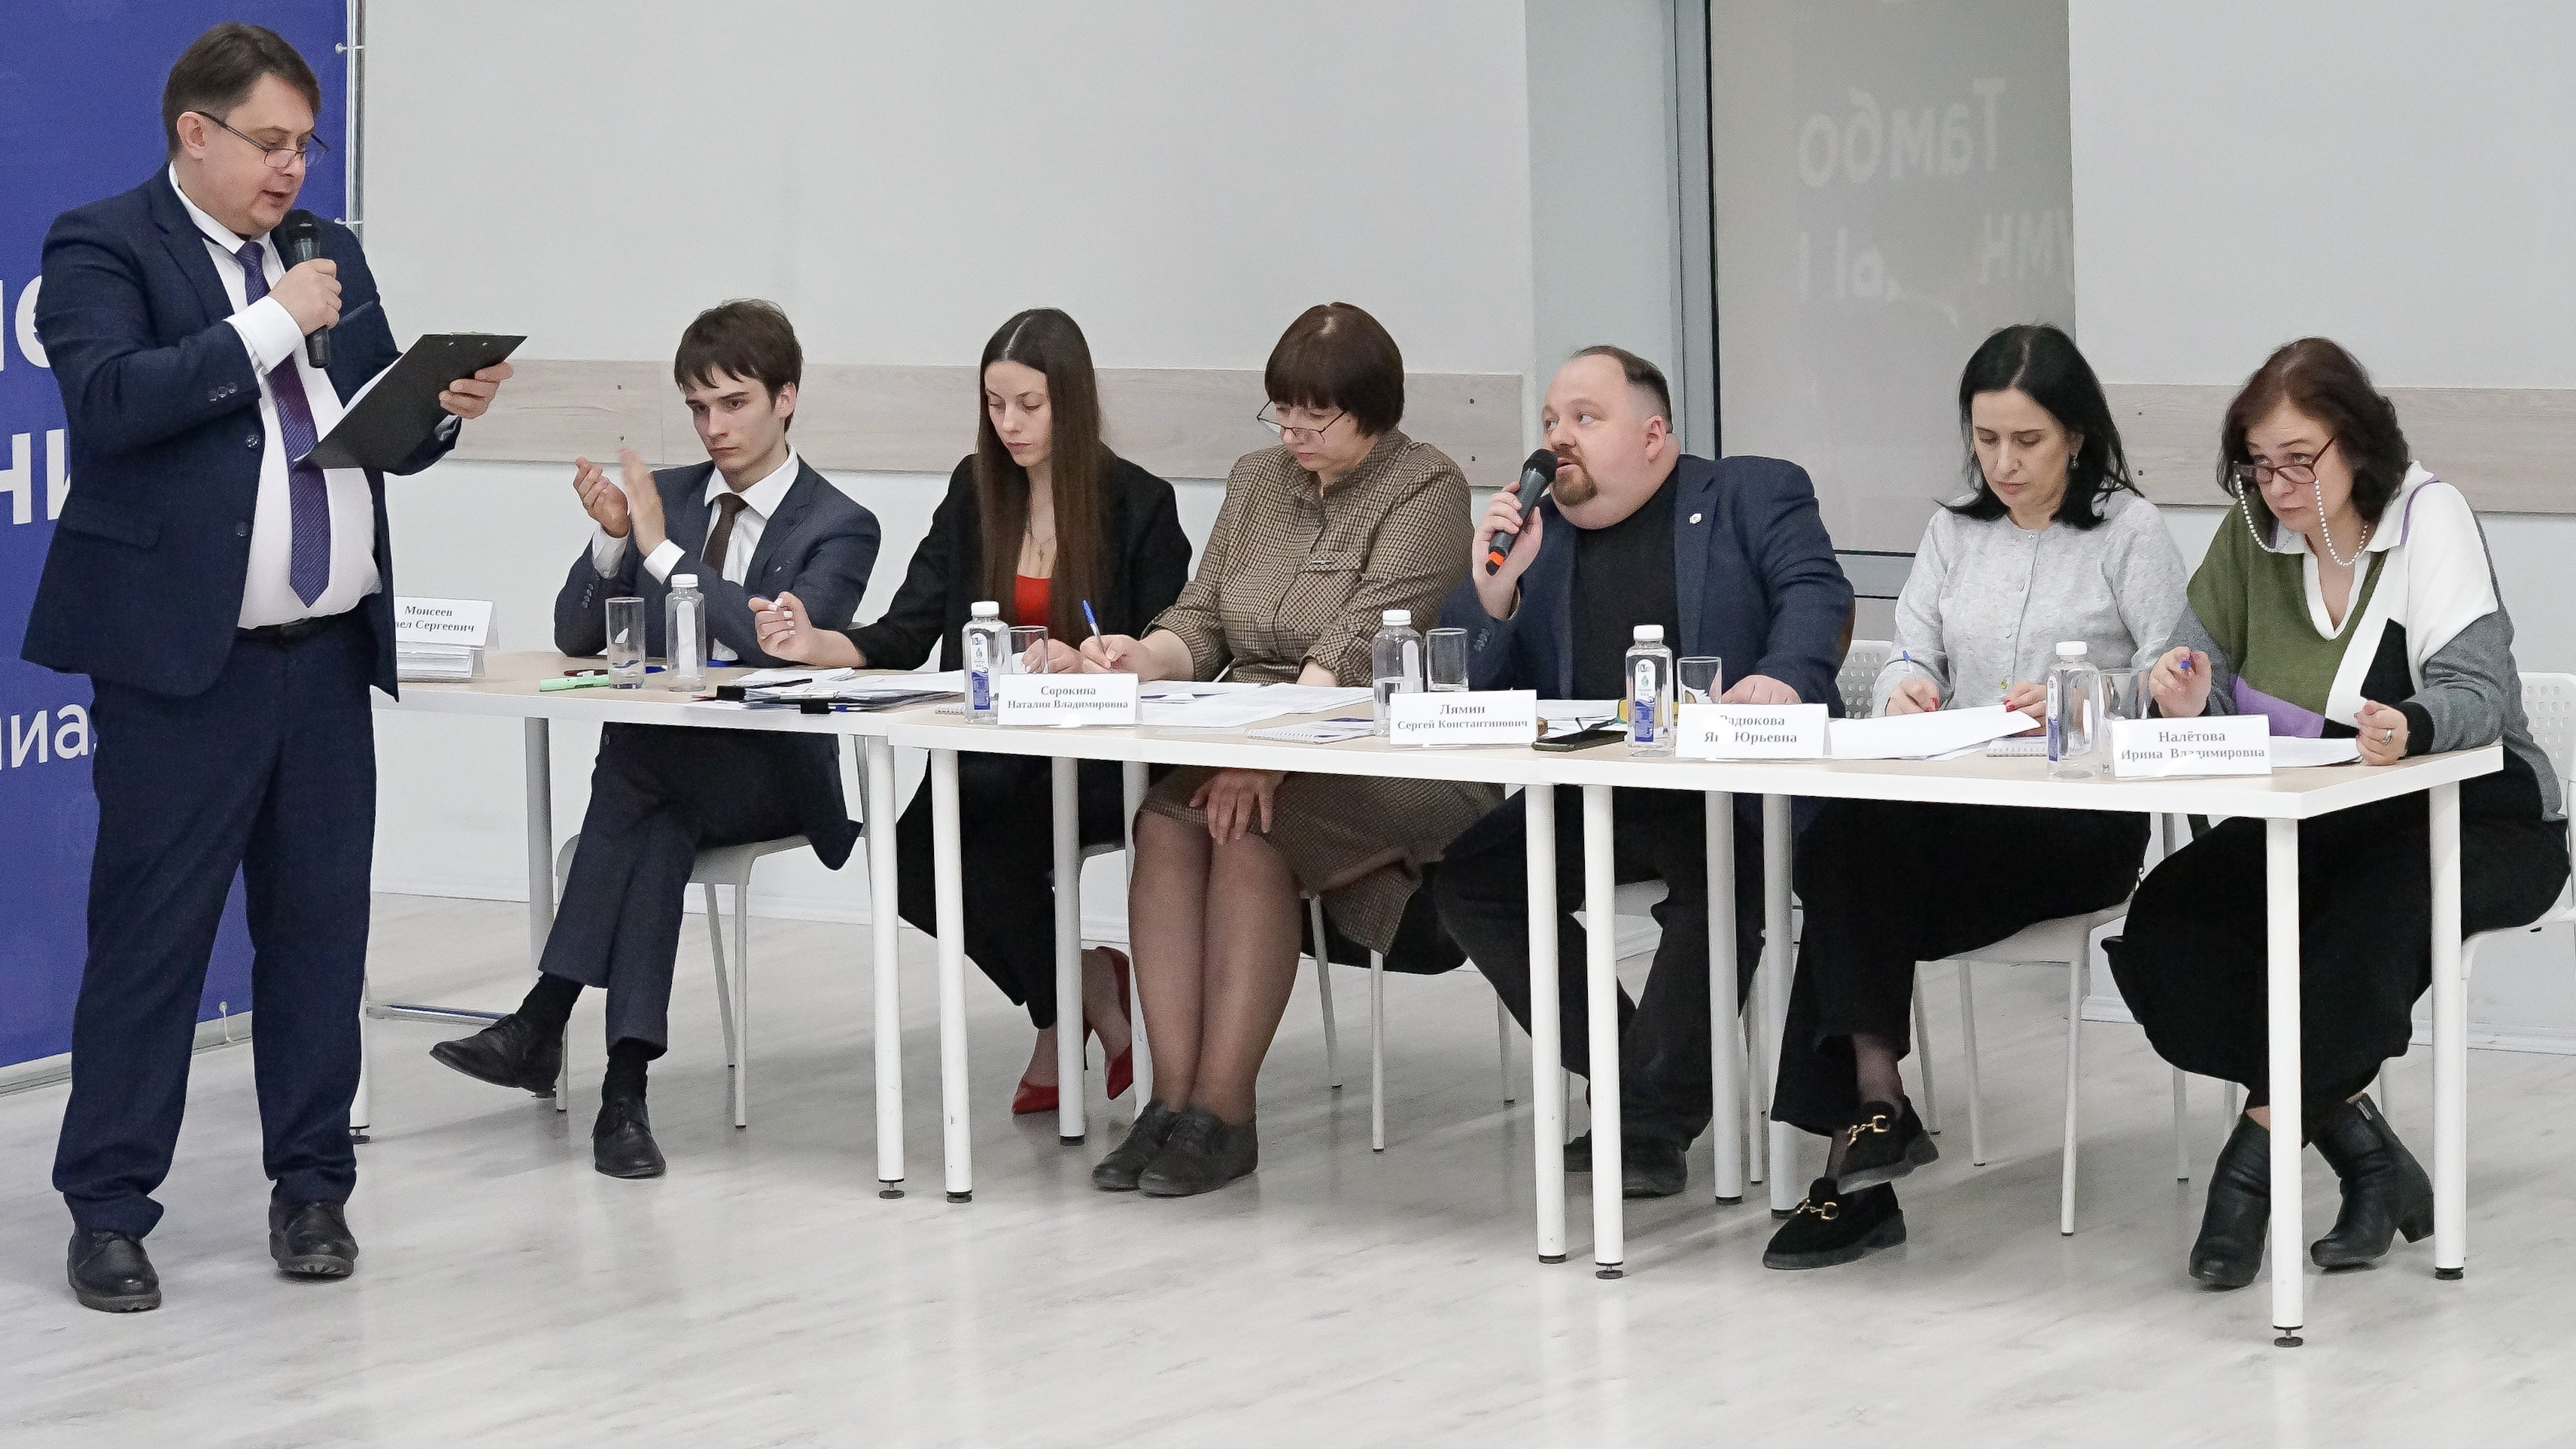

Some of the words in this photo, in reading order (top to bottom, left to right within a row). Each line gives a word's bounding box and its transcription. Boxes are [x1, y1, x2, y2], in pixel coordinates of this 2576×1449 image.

[405, 606, 453, 617] Моисеев
[395, 621, 412, 629] вел
[415, 620, 476, 633] Сергеевич
[1041, 685, 1096, 697] Сорокина
[1008, 700, 1051, 709] Наталия
[1054, 700, 1128, 710] Владимировна
[1439, 704, 1486, 715] Лямин
[1397, 720, 1435, 731] Сергей
[1438, 719, 1528, 728] Константинович
[0, 703, 97, 770] иа
[1735, 731, 1798, 745] Юрьевна
[2158, 731, 2226, 743] Налётова
[2121, 749, 2164, 762] Ирина
